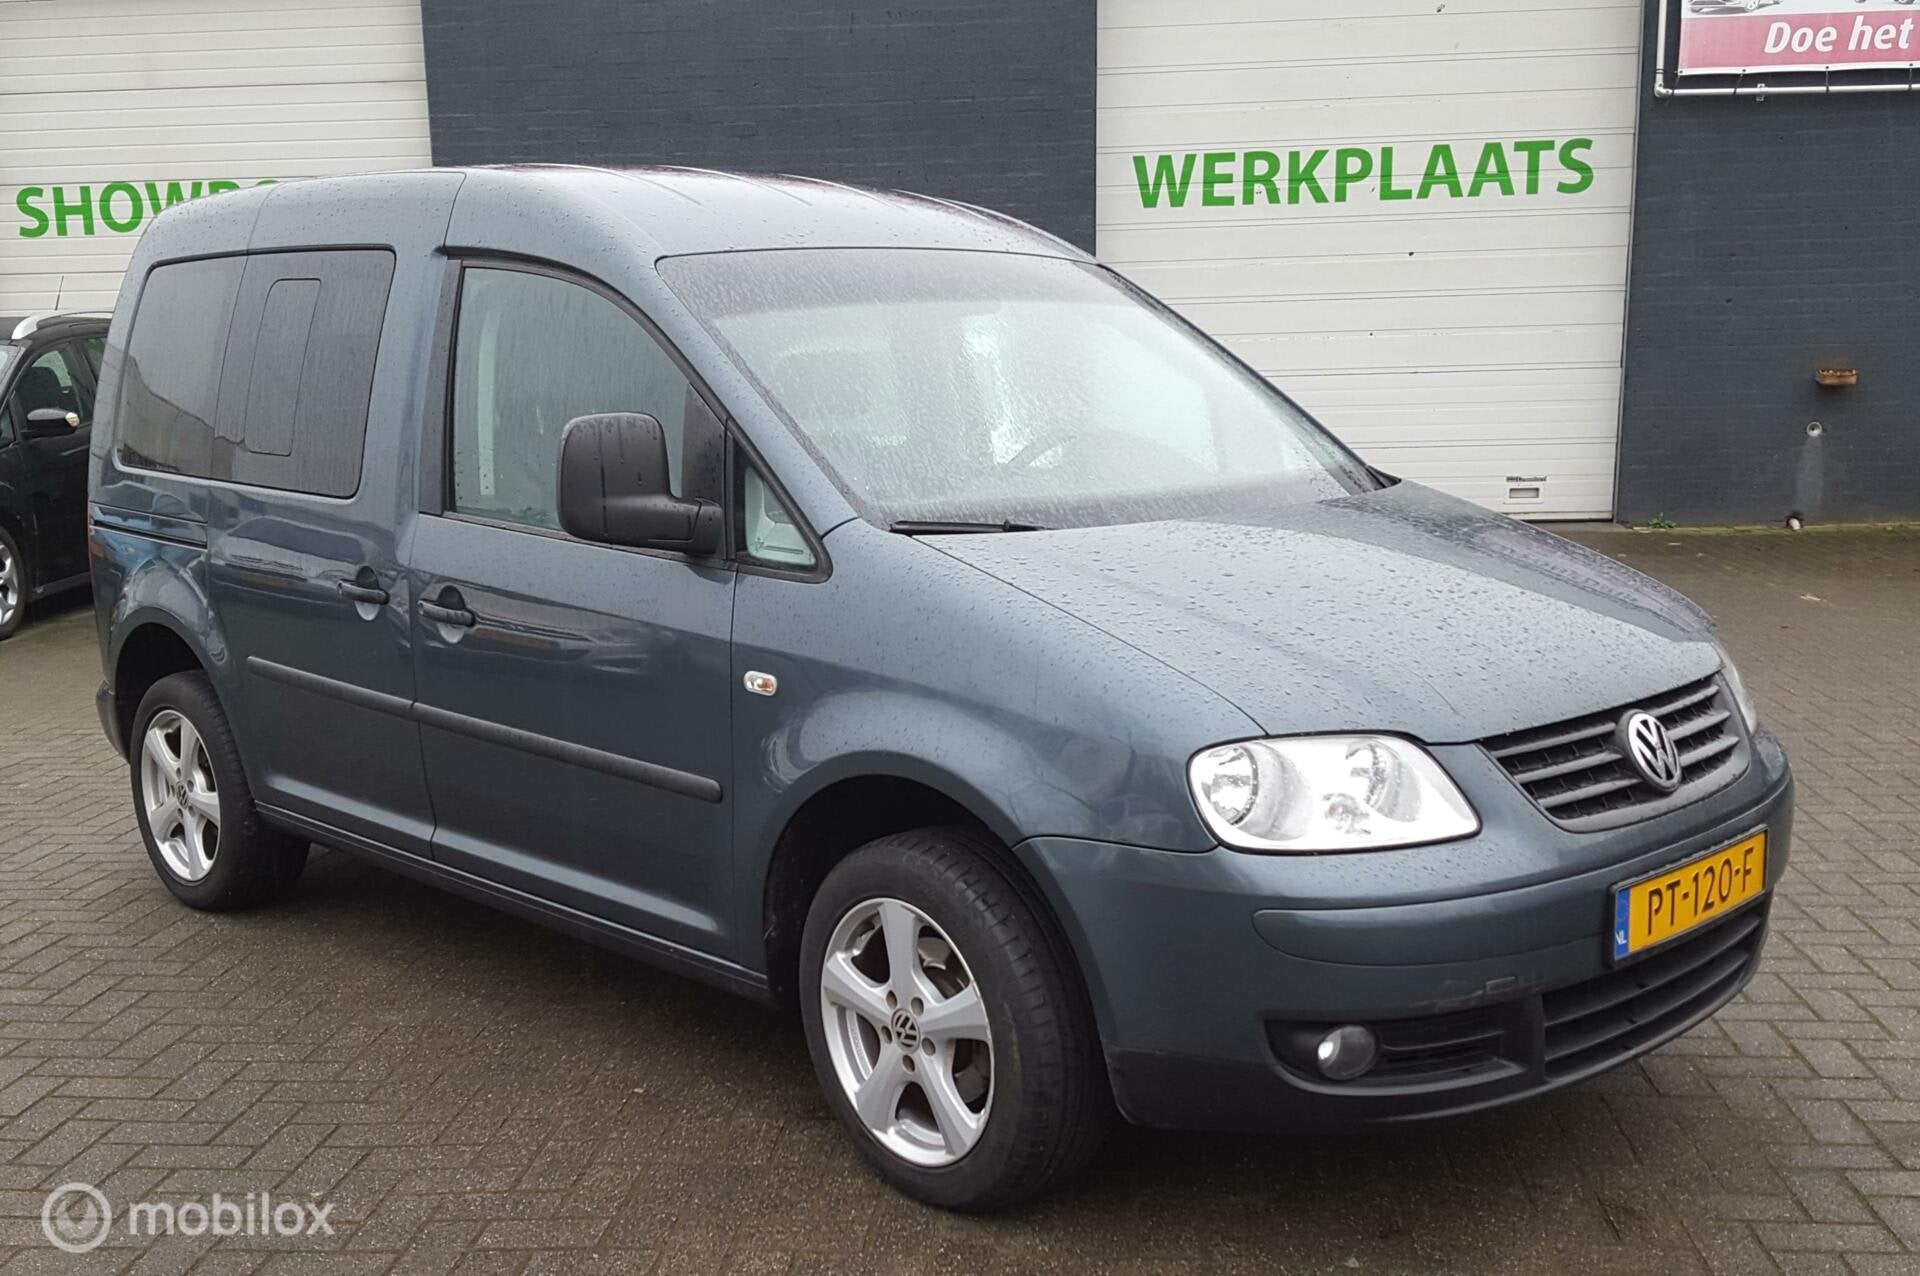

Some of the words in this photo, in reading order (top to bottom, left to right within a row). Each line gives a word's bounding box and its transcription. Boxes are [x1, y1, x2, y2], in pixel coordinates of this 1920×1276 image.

[1763, 21, 1837, 54] Doe
[1848, 15, 1914, 51] het
[1132, 137, 1594, 209] WERKPLAATS
[1648, 846, 1754, 936] PT-120-F
